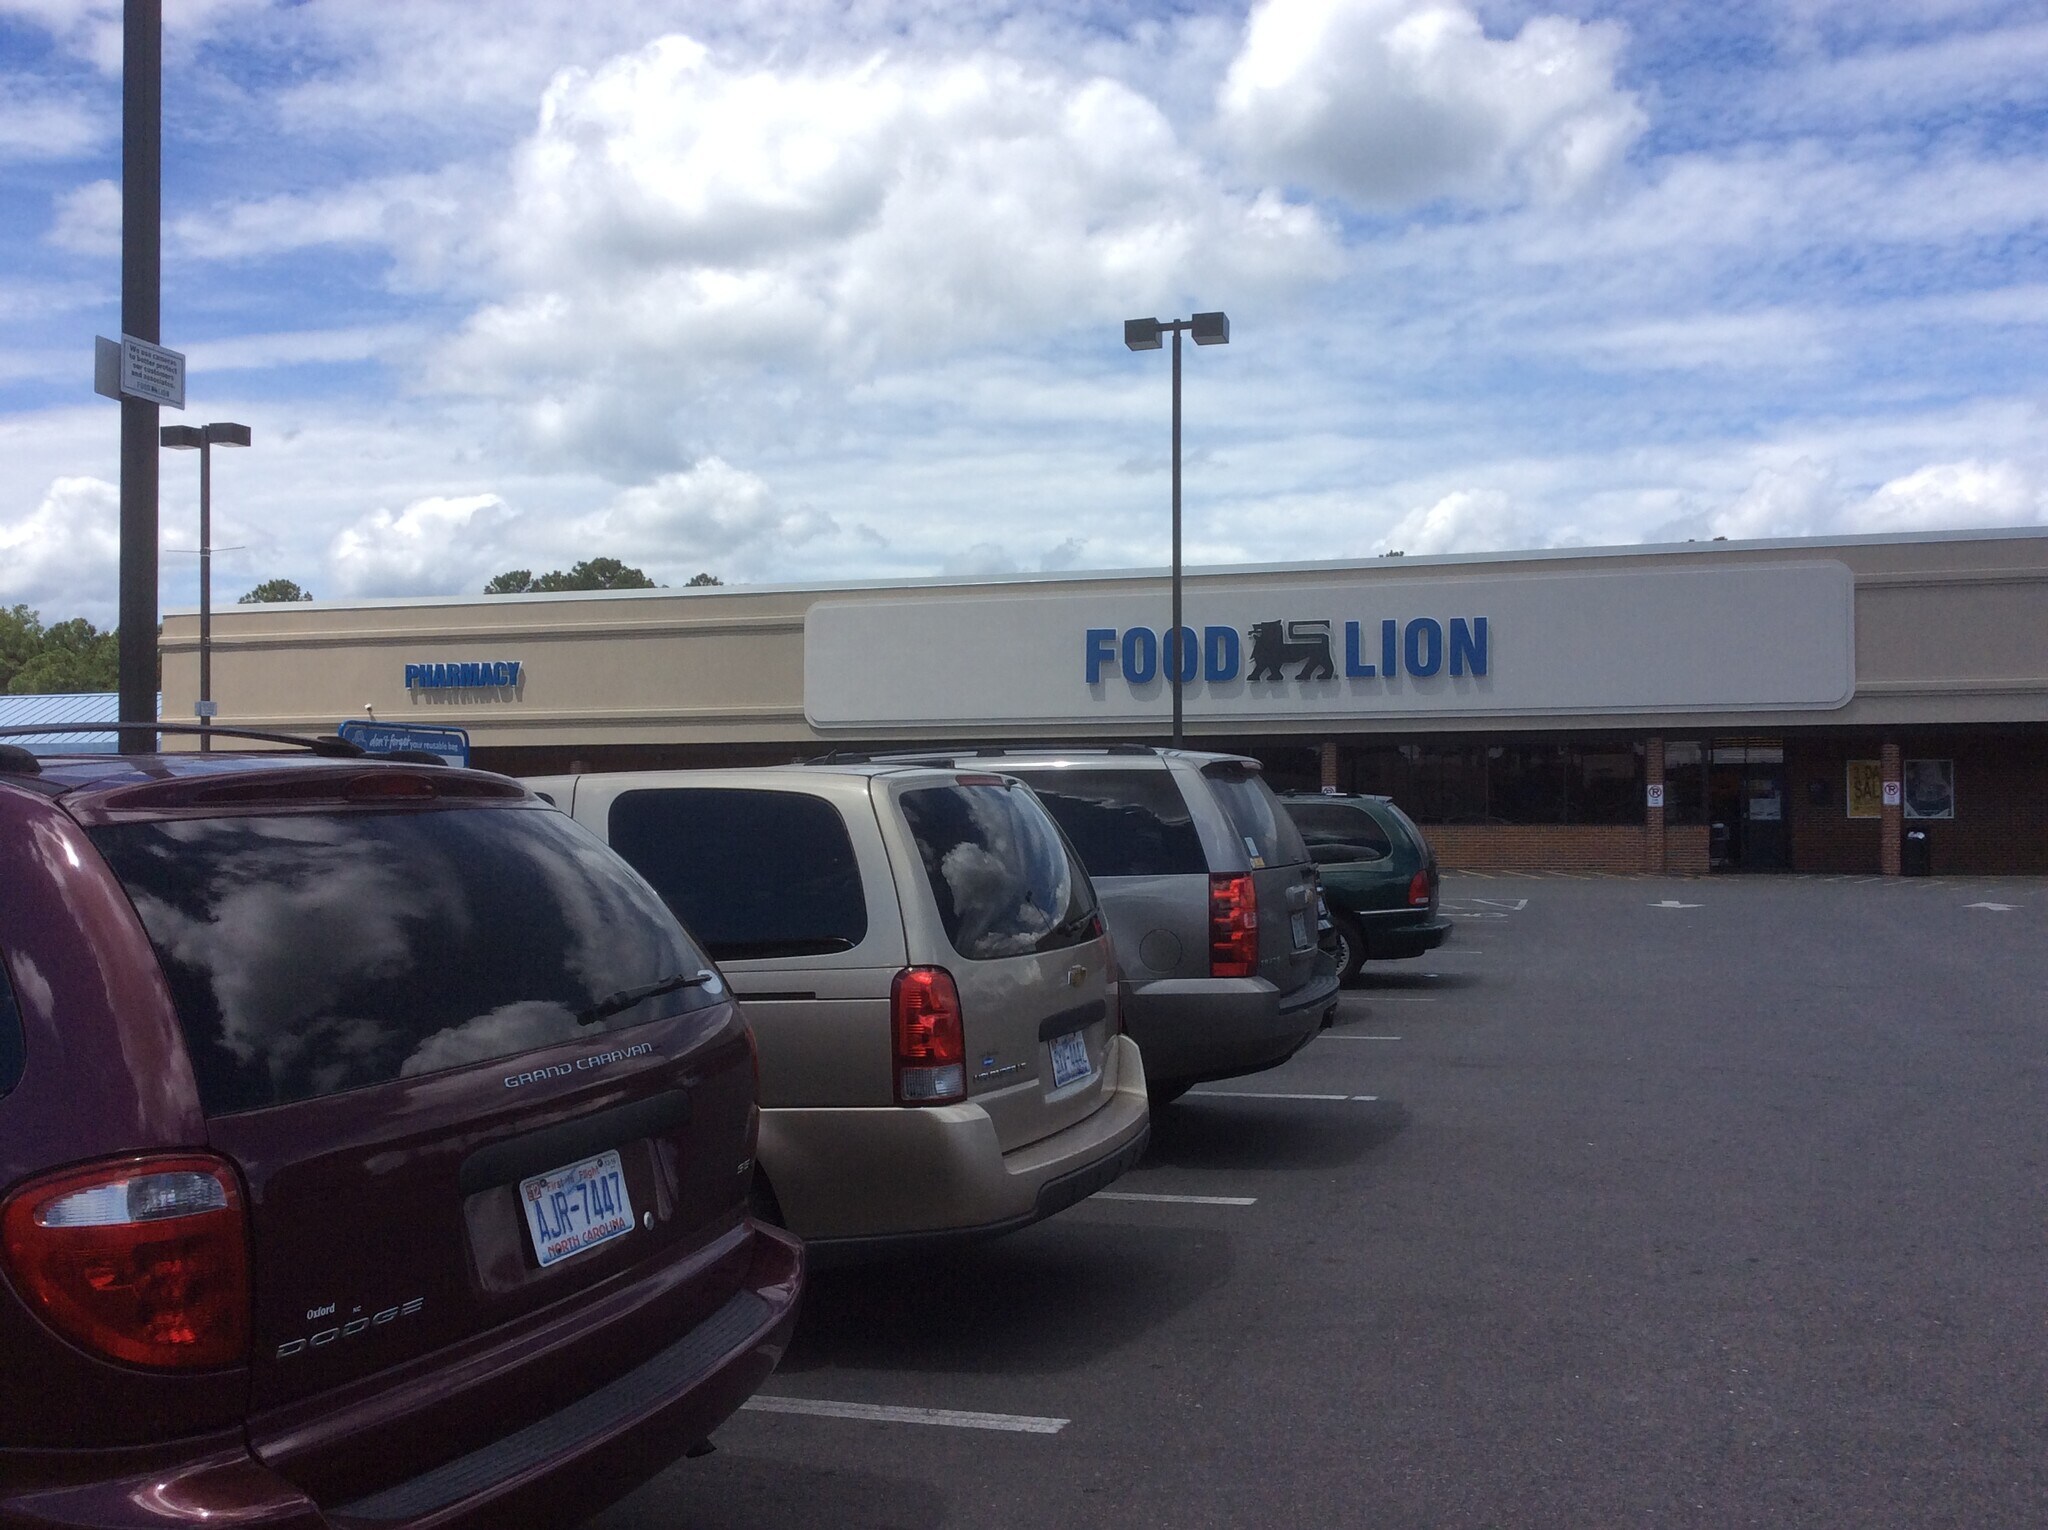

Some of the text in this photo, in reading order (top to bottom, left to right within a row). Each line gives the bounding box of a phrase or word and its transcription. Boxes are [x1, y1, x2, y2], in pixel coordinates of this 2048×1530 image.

[129, 344, 140, 354] We
[140, 349, 152, 358] use
[129, 352, 177, 375] to better protect
[131, 370, 142, 378] and
[143, 366, 174, 381] customers
[1086, 616, 1488, 684] FOOD LION
[405, 661, 522, 689] PHARMACY
[369, 733, 458, 752] don't forget your reusable bag
[1854, 781, 1881, 799] SAL
[504, 1042, 653, 1088] GRAND CARAVAN
[546, 1178, 564, 1192] First
[578, 1166, 600, 1179] Flight
[535, 1171, 623, 1243] AJR-7447
[548, 1217, 626, 1258] NORTH CAROLINA
[306, 1302, 336, 1320] Oxford
[276, 1297, 424, 1359] DODGE
